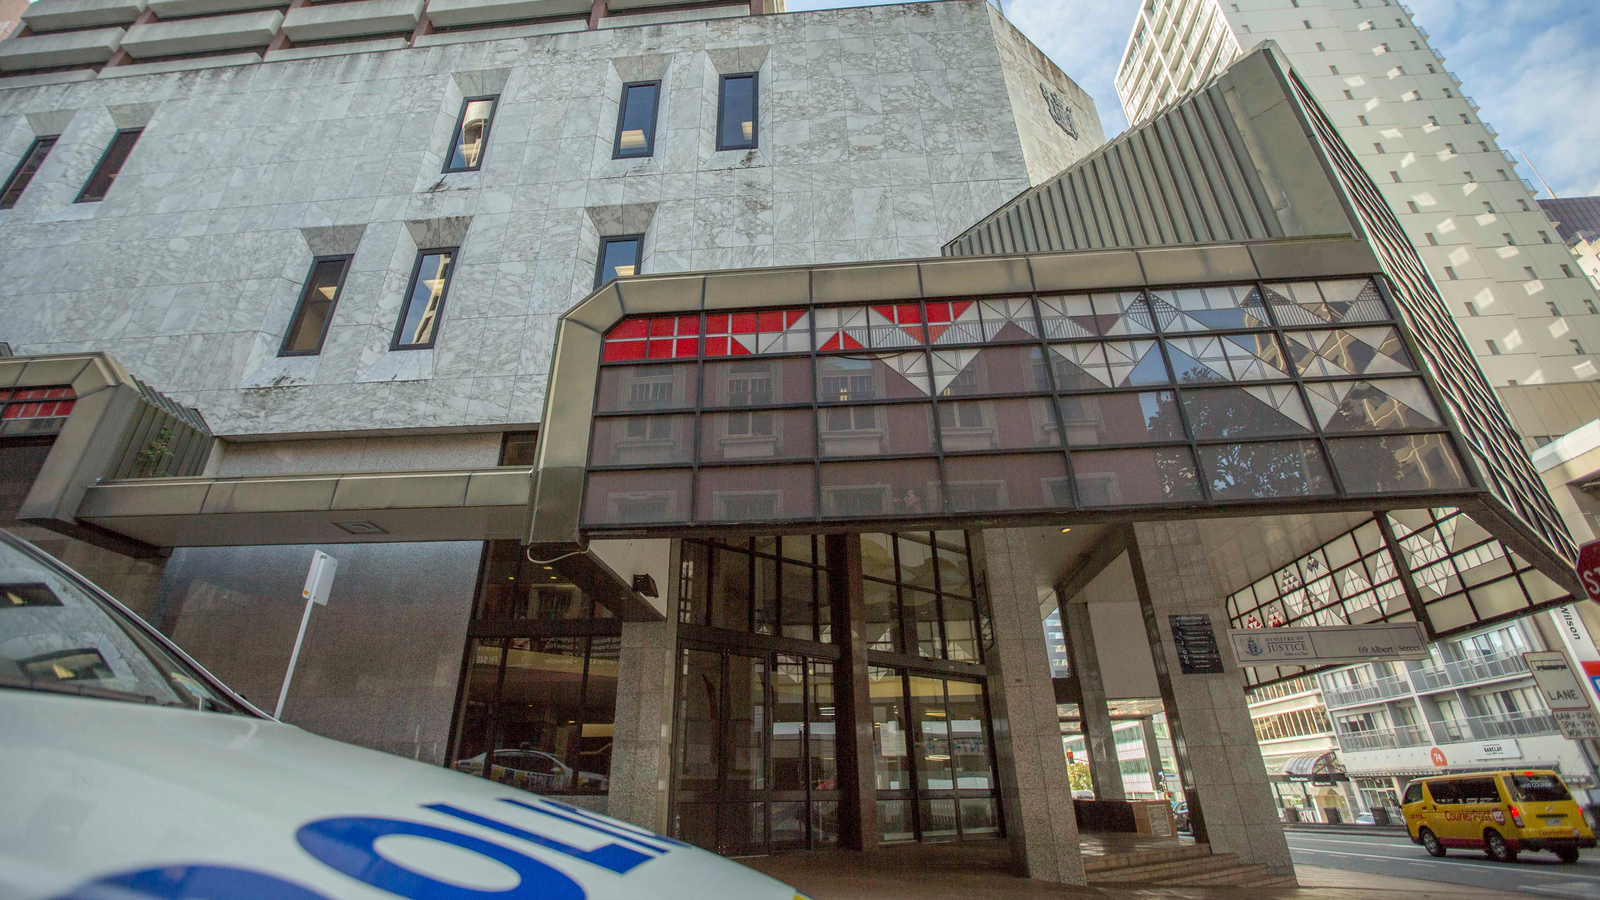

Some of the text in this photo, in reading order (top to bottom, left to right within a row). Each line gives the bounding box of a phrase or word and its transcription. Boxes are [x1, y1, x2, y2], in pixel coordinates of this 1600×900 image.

[1267, 643, 1308, 654] JUSTICE
[1358, 644, 1421, 654] 69 Albert Street
[1547, 689, 1579, 701] LANE
[1556, 712, 1571, 721] 6AM
[1575, 711, 1593, 720] 10AM
[1561, 721, 1576, 729] 3PM
[1580, 720, 1597, 729] 7PM
[1566, 729, 1583, 737] MON
[1587, 728, 1599, 737] FRI
[1445, 809, 1492, 822] CourierPost
